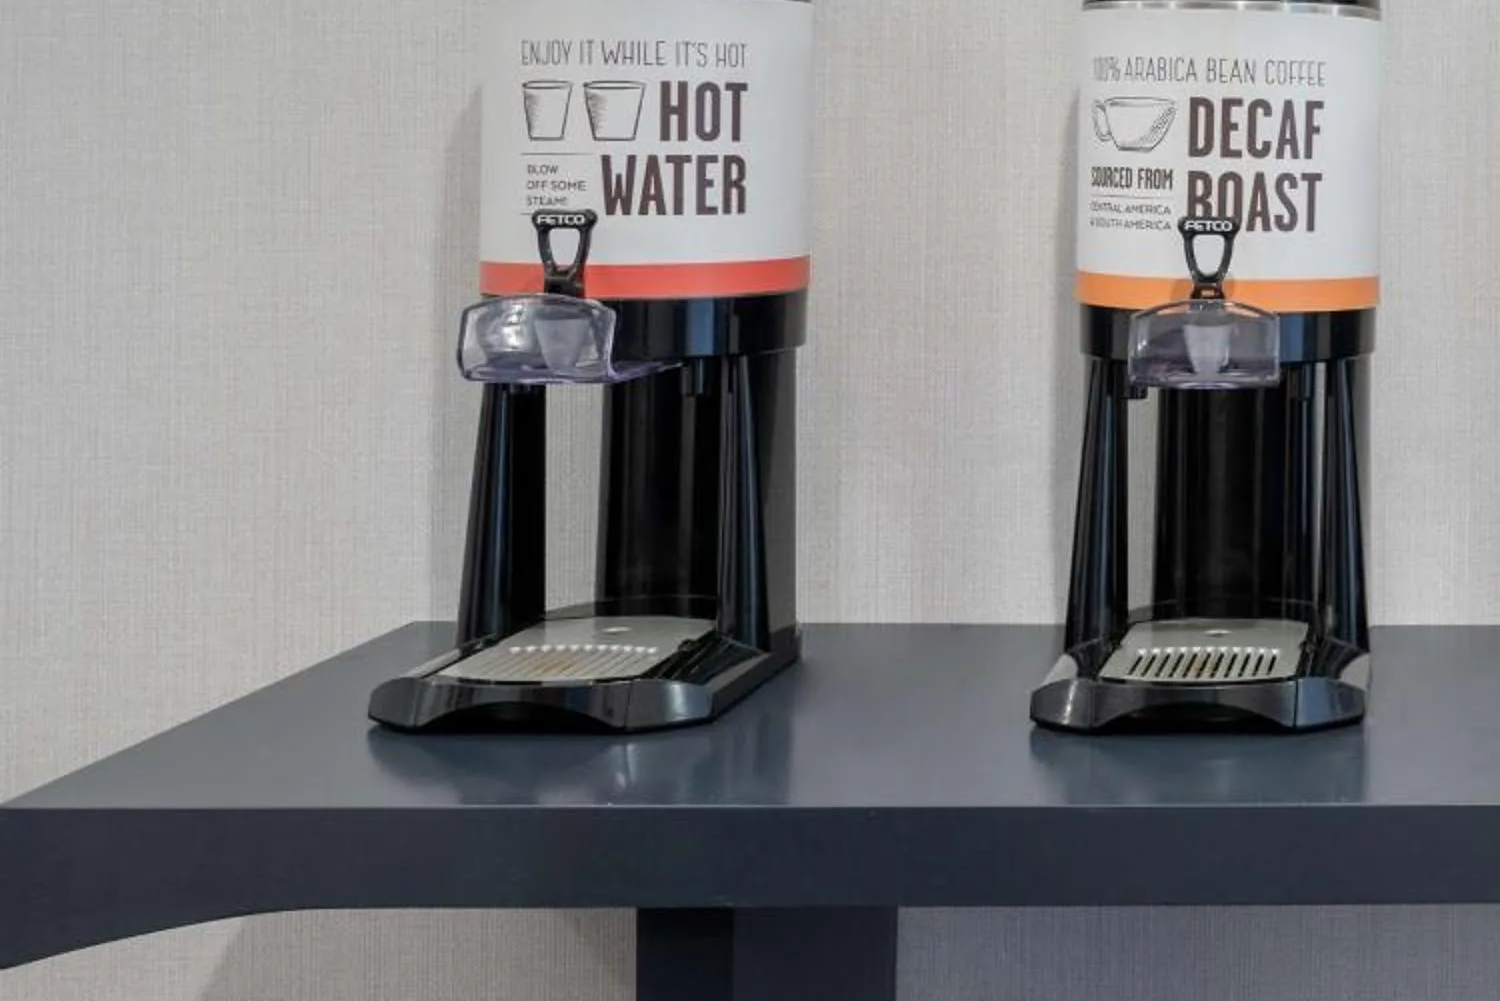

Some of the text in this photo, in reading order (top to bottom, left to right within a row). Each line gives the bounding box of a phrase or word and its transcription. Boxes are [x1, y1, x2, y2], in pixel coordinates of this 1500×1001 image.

[521, 40, 748, 68] ENJOY IT WHILE IT'S HOT
[1124, 56, 1197, 82] ARABICA
[1206, 58, 1256, 84] BEAN
[1265, 60, 1326, 87] COFFEE
[660, 81, 748, 142] HOT
[1188, 96, 1325, 160] DECAF
[551, 180, 587, 191] SOME
[601, 154, 747, 216] WATER
[1091, 166, 1174, 191] SOURCED FROM
[1124, 203, 1172, 215] AMERICA
[1187, 170, 1323, 232] ROAST
[537, 214, 586, 226] FETCO
[1124, 219, 1172, 231] AMERICA
[1184, 220, 1233, 232] FETCO
